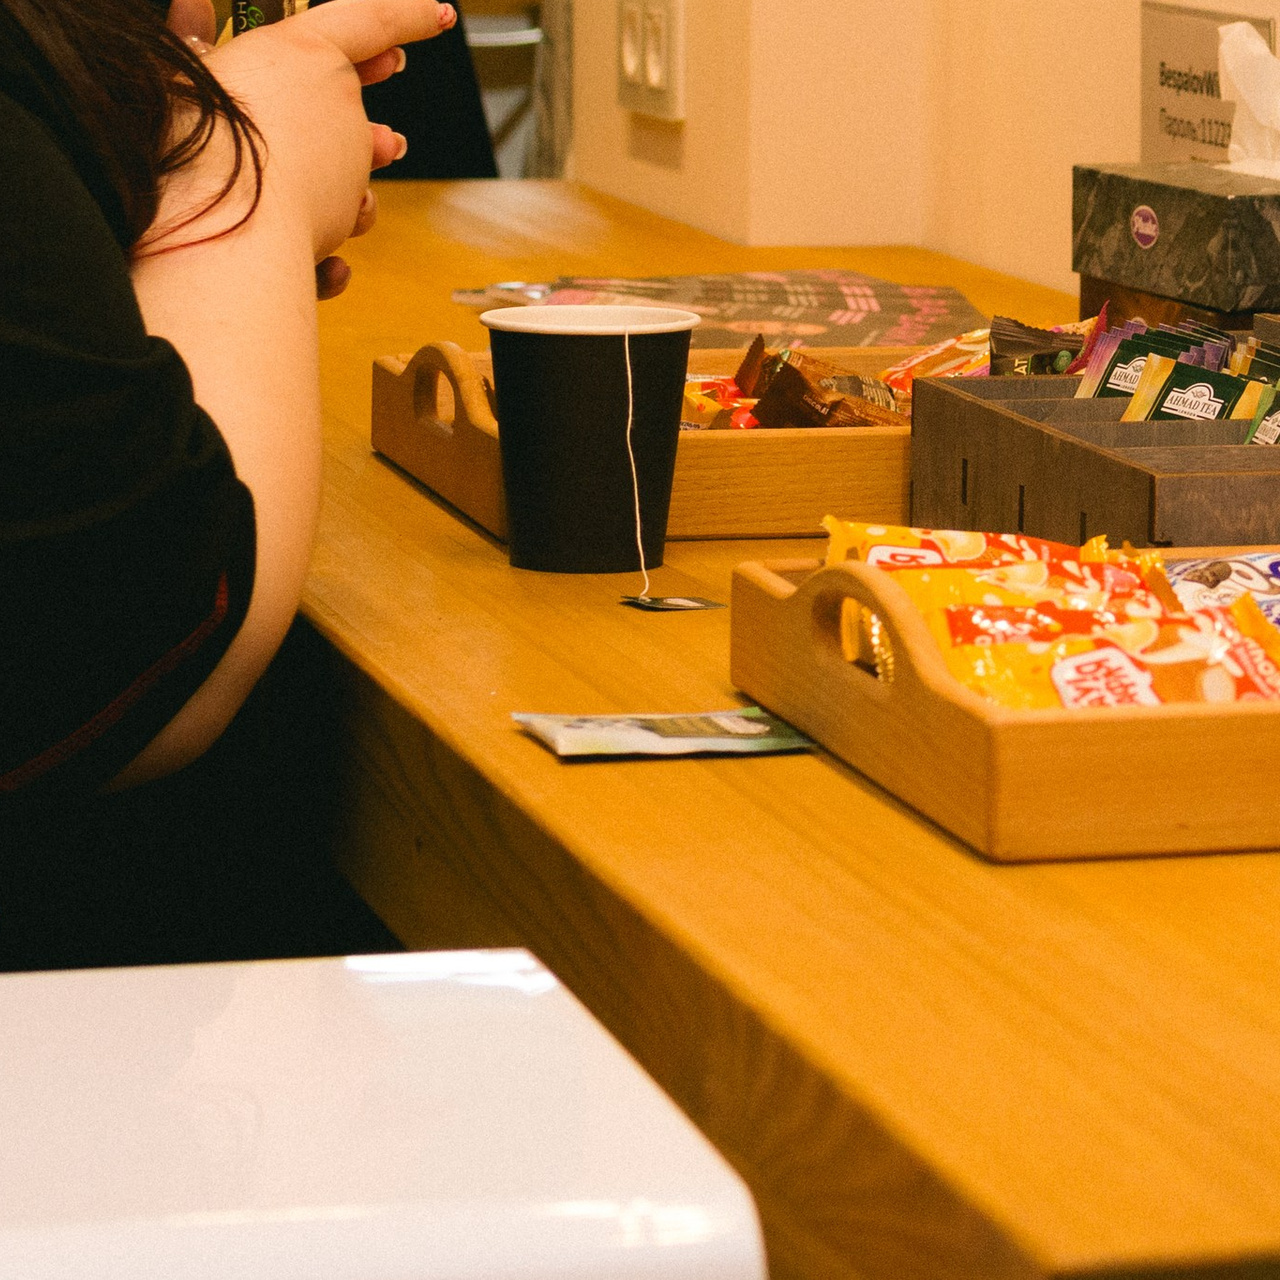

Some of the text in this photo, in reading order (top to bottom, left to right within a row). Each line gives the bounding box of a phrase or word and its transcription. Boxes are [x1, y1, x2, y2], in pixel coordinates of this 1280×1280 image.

[1112, 369, 1140, 386] AHMAD
[1166, 394, 1218, 417] AHMAD TEA
